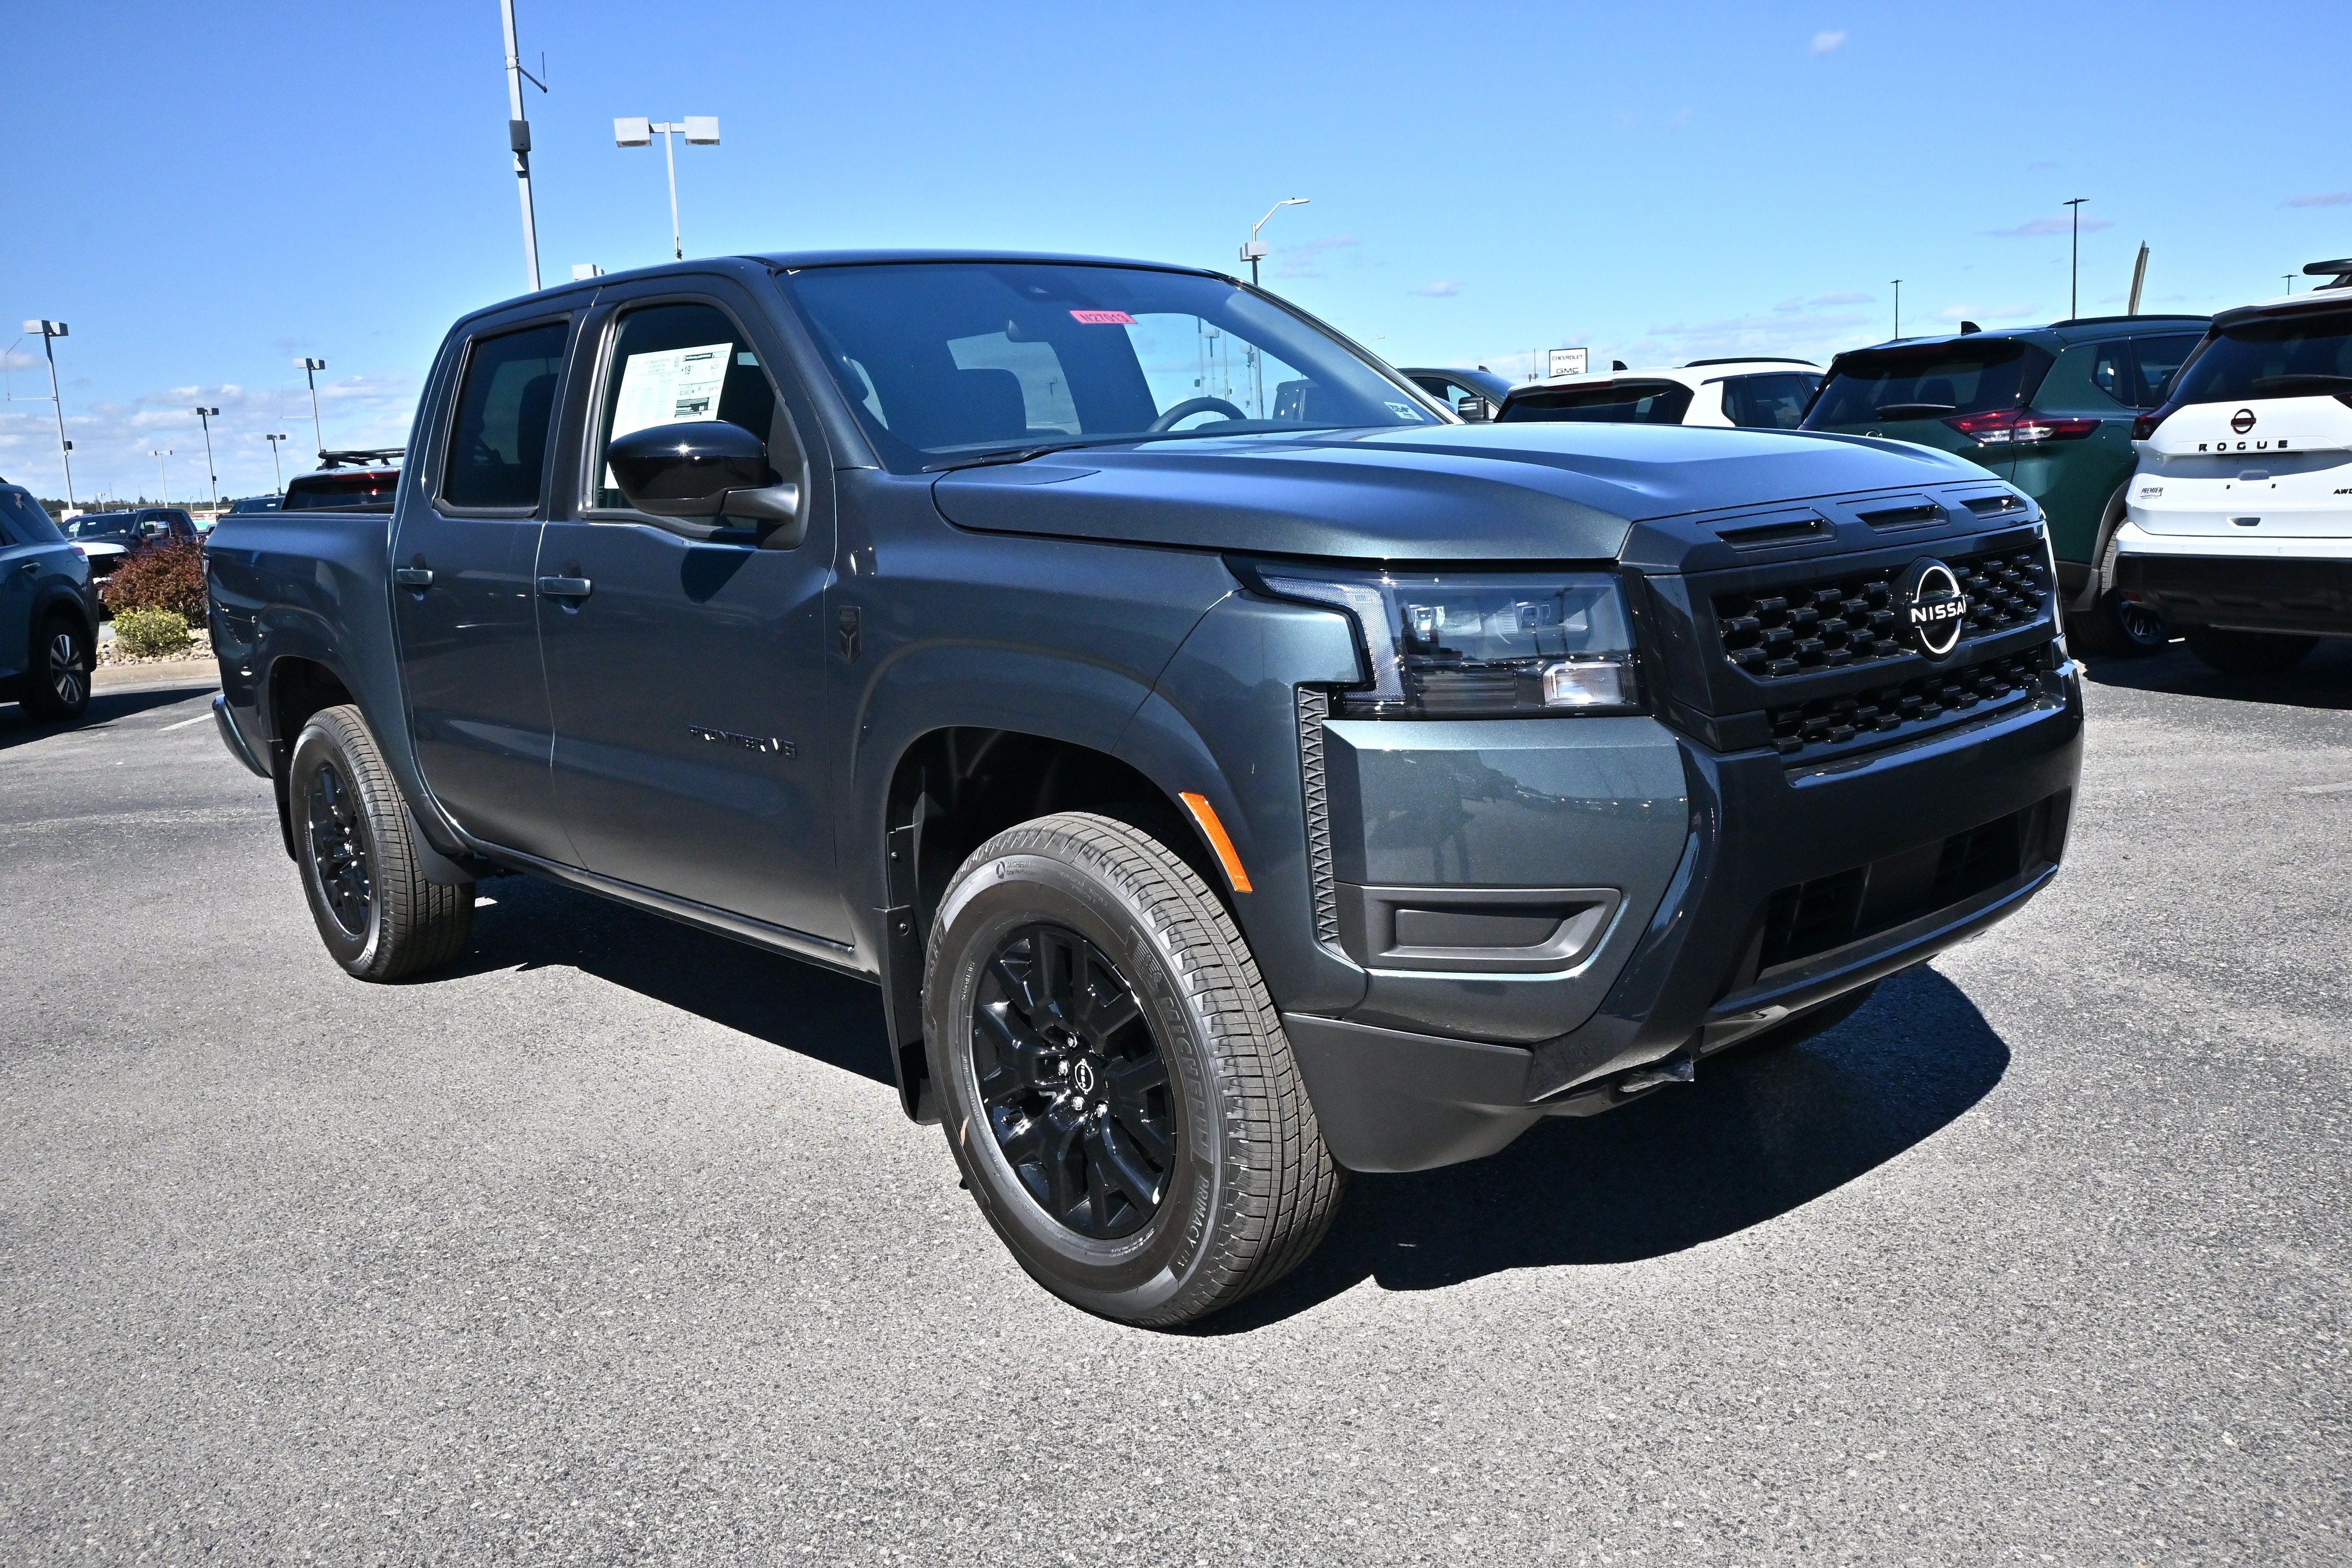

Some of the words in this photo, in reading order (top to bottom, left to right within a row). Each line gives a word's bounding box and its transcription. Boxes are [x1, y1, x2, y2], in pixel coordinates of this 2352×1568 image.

[1080, 313, 1129, 322] N27013
[684, 365, 691, 375] 19
[2198, 440, 2288, 452] ROGUE
[1185, 1174, 1210, 1249] PRIMACY
